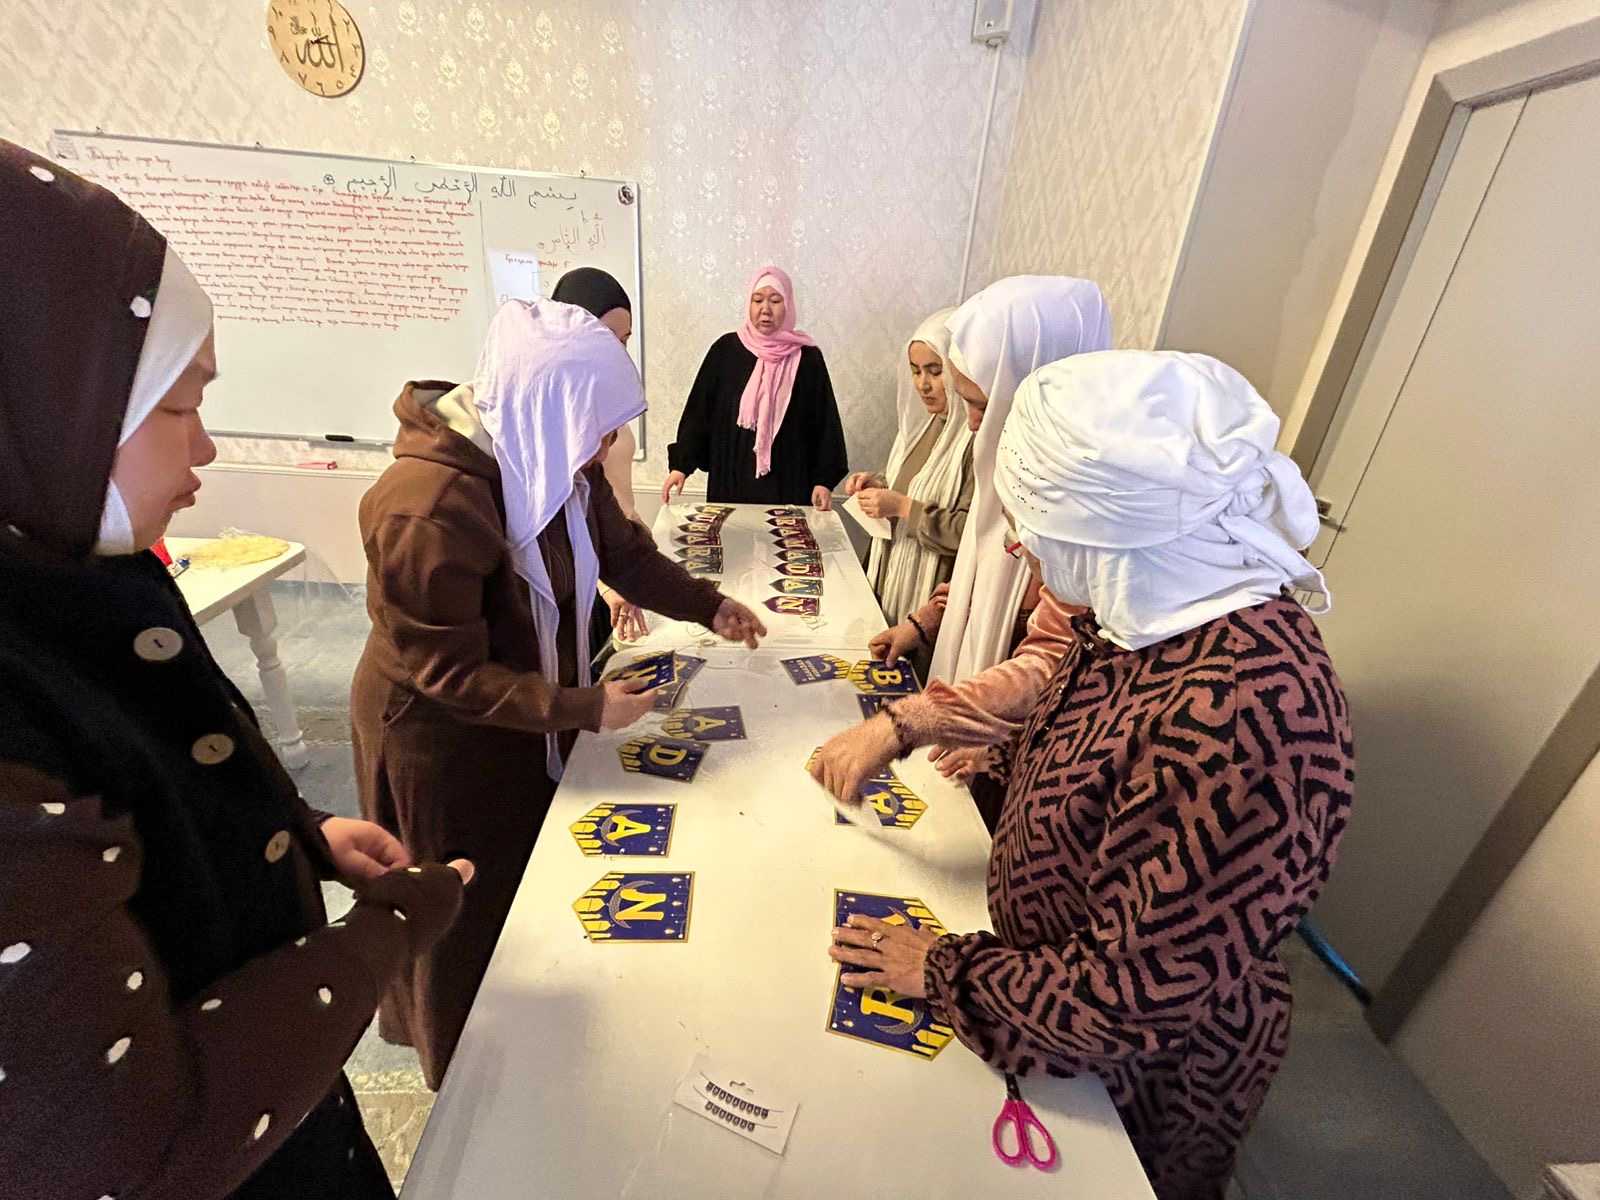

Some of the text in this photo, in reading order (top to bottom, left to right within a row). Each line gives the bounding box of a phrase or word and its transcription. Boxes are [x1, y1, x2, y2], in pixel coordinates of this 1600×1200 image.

[871, 668, 903, 685] B
[607, 716, 726, 921] A D A N
